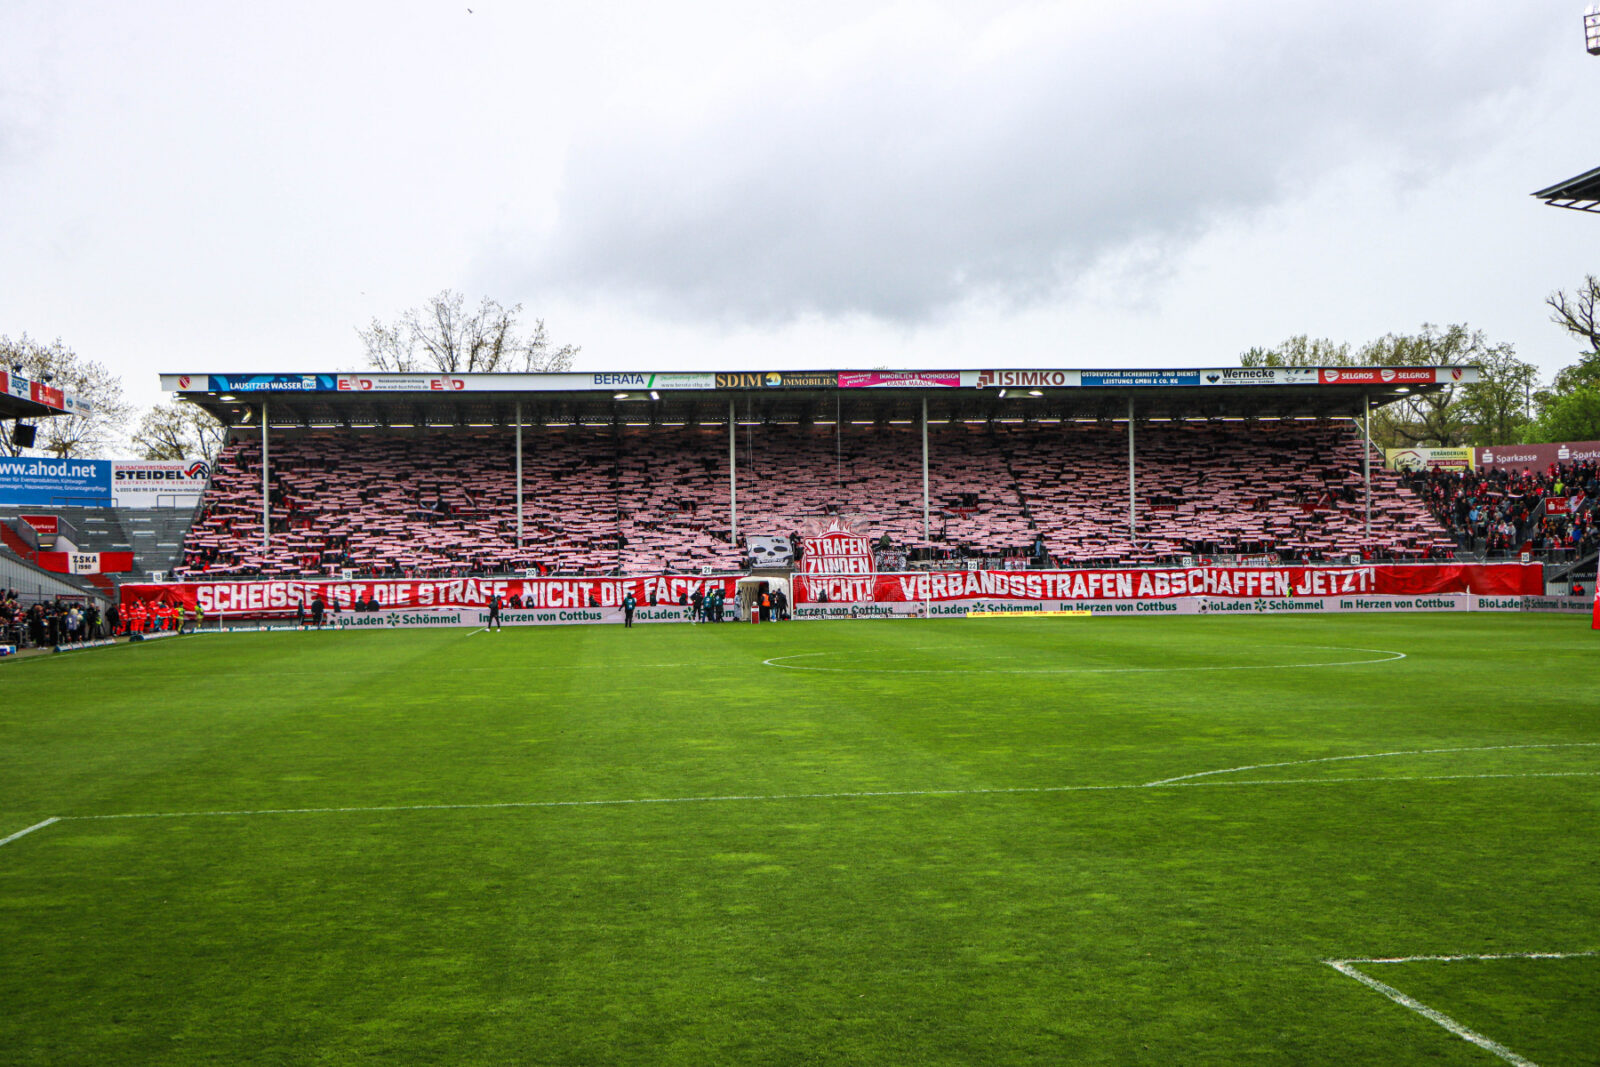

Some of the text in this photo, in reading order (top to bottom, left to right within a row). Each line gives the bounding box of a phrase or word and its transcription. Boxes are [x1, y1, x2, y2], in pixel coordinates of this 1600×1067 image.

[998, 371, 1065, 386] ISIMKO
[1222, 369, 1274, 378] Wernecke
[594, 374, 645, 385] BERATA
[716, 373, 762, 388] SDIM
[783, 377, 838, 386] IMMOBILIEN
[230, 382, 302, 390] LAUSITZER WASSER
[1496, 453, 1538, 464] Sparkasse
[115, 470, 185, 480] STEIDEL
[805, 538, 868, 556] STRAFEN
[72, 555, 97, 563] ZSKA
[1183, 557, 1191, 565] 23
[805, 556, 869, 574] ZÜNDEN
[899, 567, 1376, 601] VERBANDSSTRAFEN ABSCHAFFEN JETZT!
[808, 578, 873, 602] NICHT!
[197, 582, 320, 612] SCHEISSE
[326, 582, 367, 607] IST
[373, 582, 412, 606] DIE
[521, 581, 594, 608] NICHT
[600, 580, 637, 607] DIE
[987, 602, 1043, 612] Schömmel
[1060, 602, 1073, 611] Im
[1076, 602, 1113, 612] Herzen
[1114, 603, 1134, 611] von
[1136, 601, 1177, 612] Cottbus
[1269, 600, 1324, 611] Schömmel
[1340, 598, 1456, 609] Im Herzen von Cottbus
[851, 604, 893, 615] Cottbus
[402, 613, 462, 625] Schömmel
[536, 612, 557, 622] von
[559, 610, 602, 621] Cottbus
